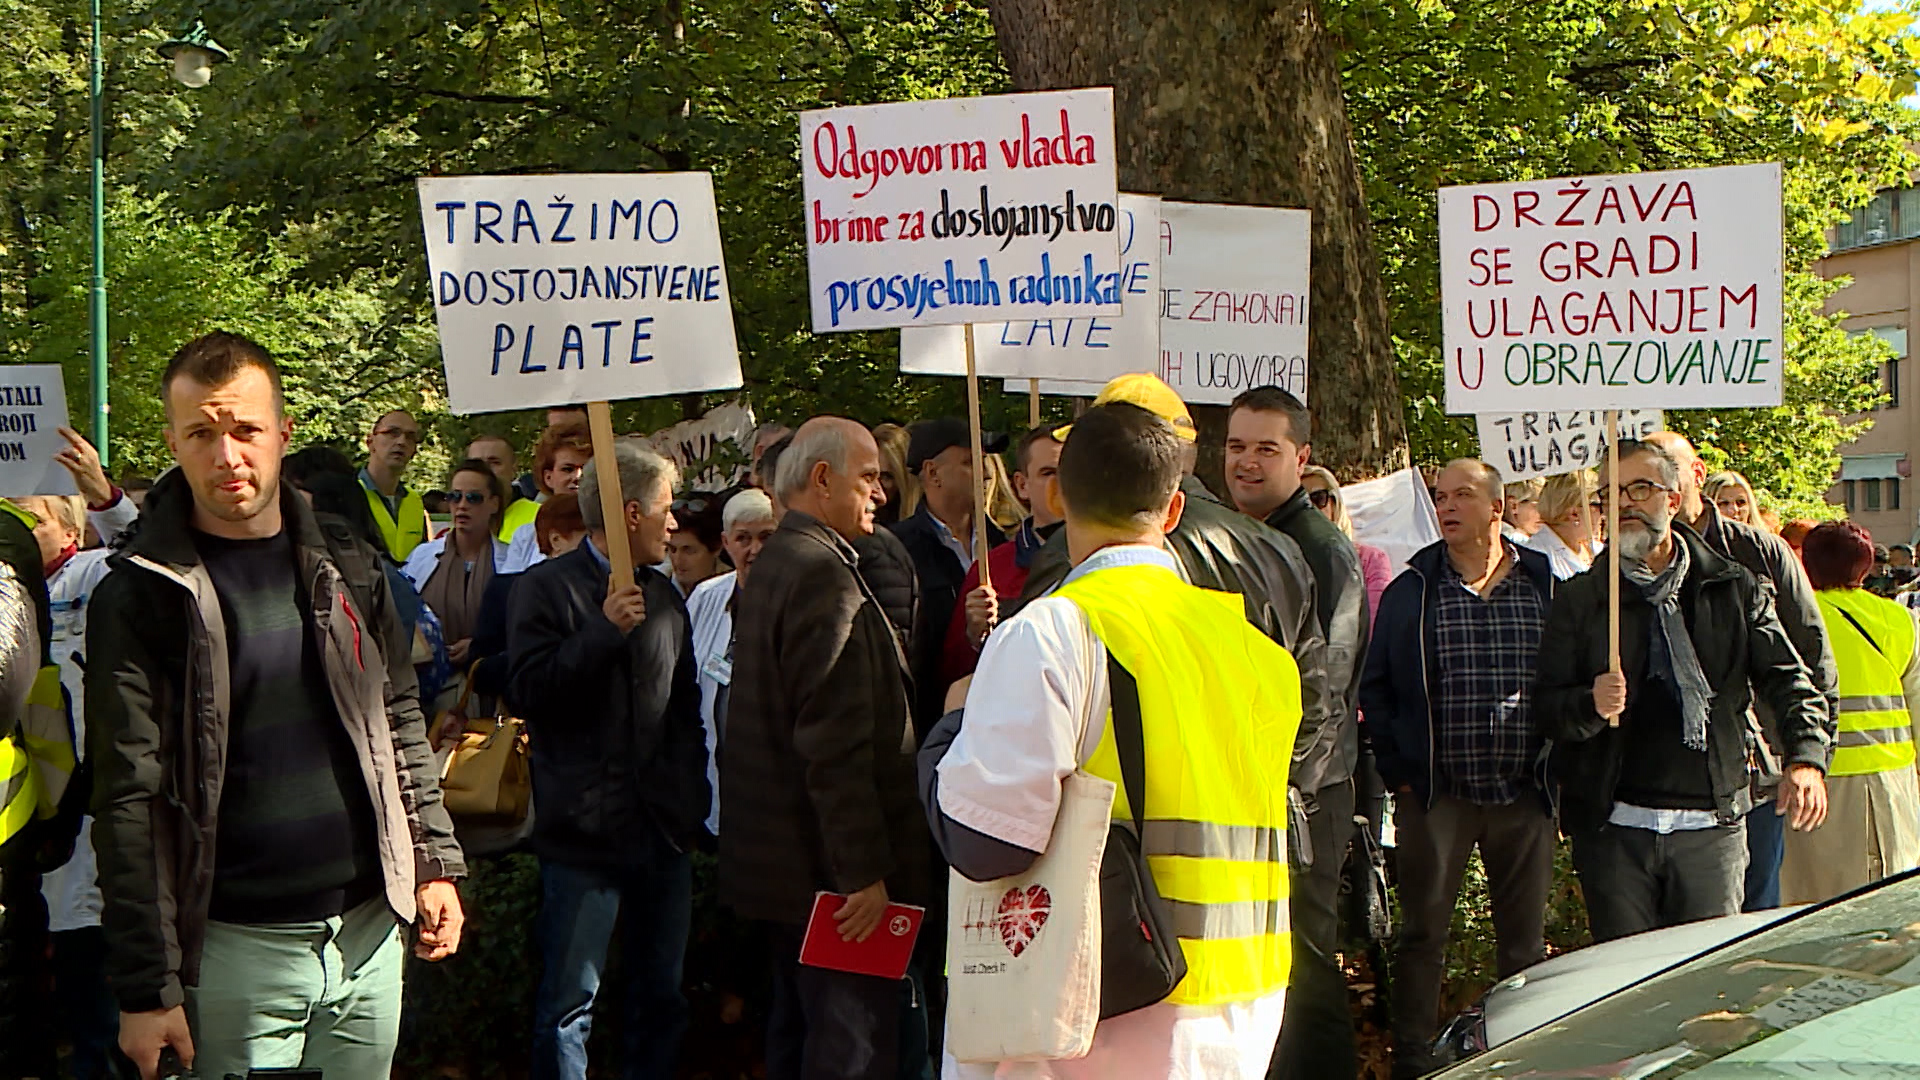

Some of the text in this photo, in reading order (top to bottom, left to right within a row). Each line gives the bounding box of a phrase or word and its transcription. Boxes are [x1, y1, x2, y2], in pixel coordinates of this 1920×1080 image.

[814, 109, 1095, 199] Odgovorna vlada
[435, 194, 679, 243] TRAŽIMO
[813, 199, 894, 244] brine
[897, 210, 925, 242] za
[931, 185, 1116, 251] dostojanstvo
[1472, 180, 1698, 232] DRŽAVA
[439, 265, 720, 306] DOSTOJANSTVENE
[1009, 252, 1122, 306] radnika
[1468, 231, 1698, 287] SE GRADI
[1188, 290, 1294, 326] ZAKONA
[1467, 283, 1758, 338] ULAGANJEM
[491, 317, 654, 376] PLATE
[1196, 351, 1305, 394] UGOVORA
[1456, 338, 1773, 390] U OBRAZOVANJE
